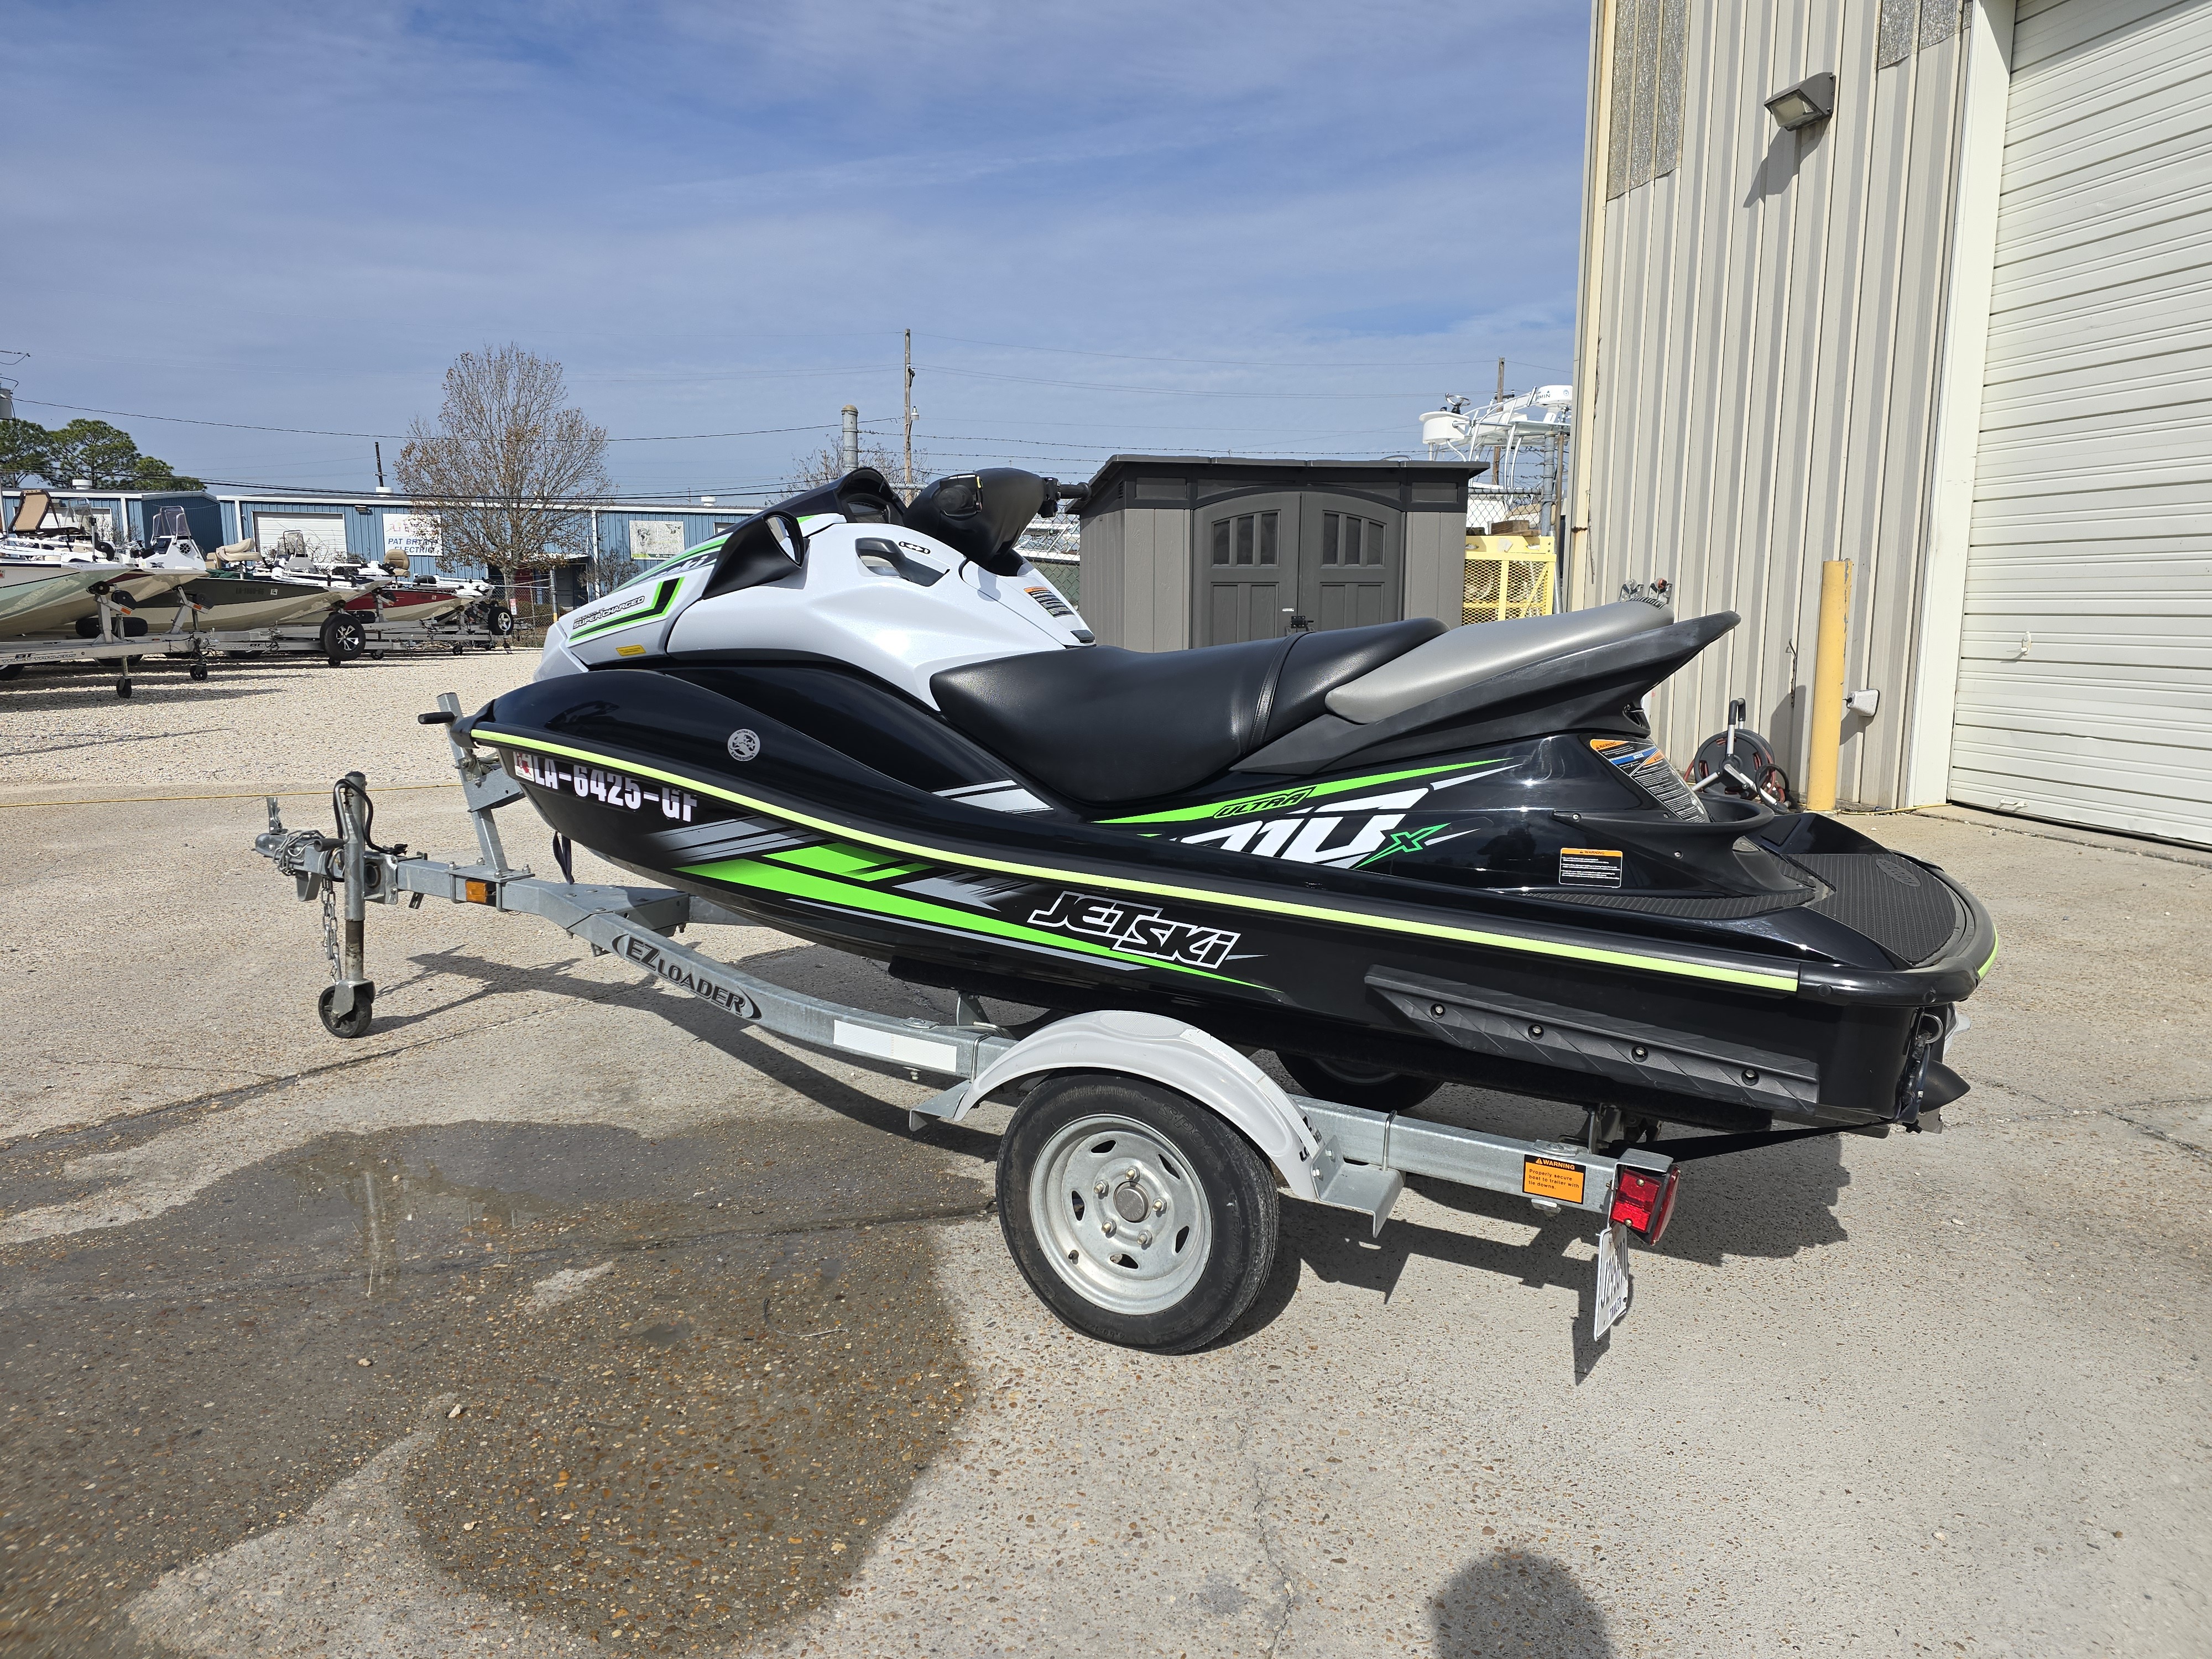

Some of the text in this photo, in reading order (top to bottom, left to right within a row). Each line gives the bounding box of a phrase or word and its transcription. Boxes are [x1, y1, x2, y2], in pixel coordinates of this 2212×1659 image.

[1215, 789, 1309, 818] ULTRA
[1542, 1159, 1575, 1170] WARNING
[1529, 1168, 1552, 1177] Properly
